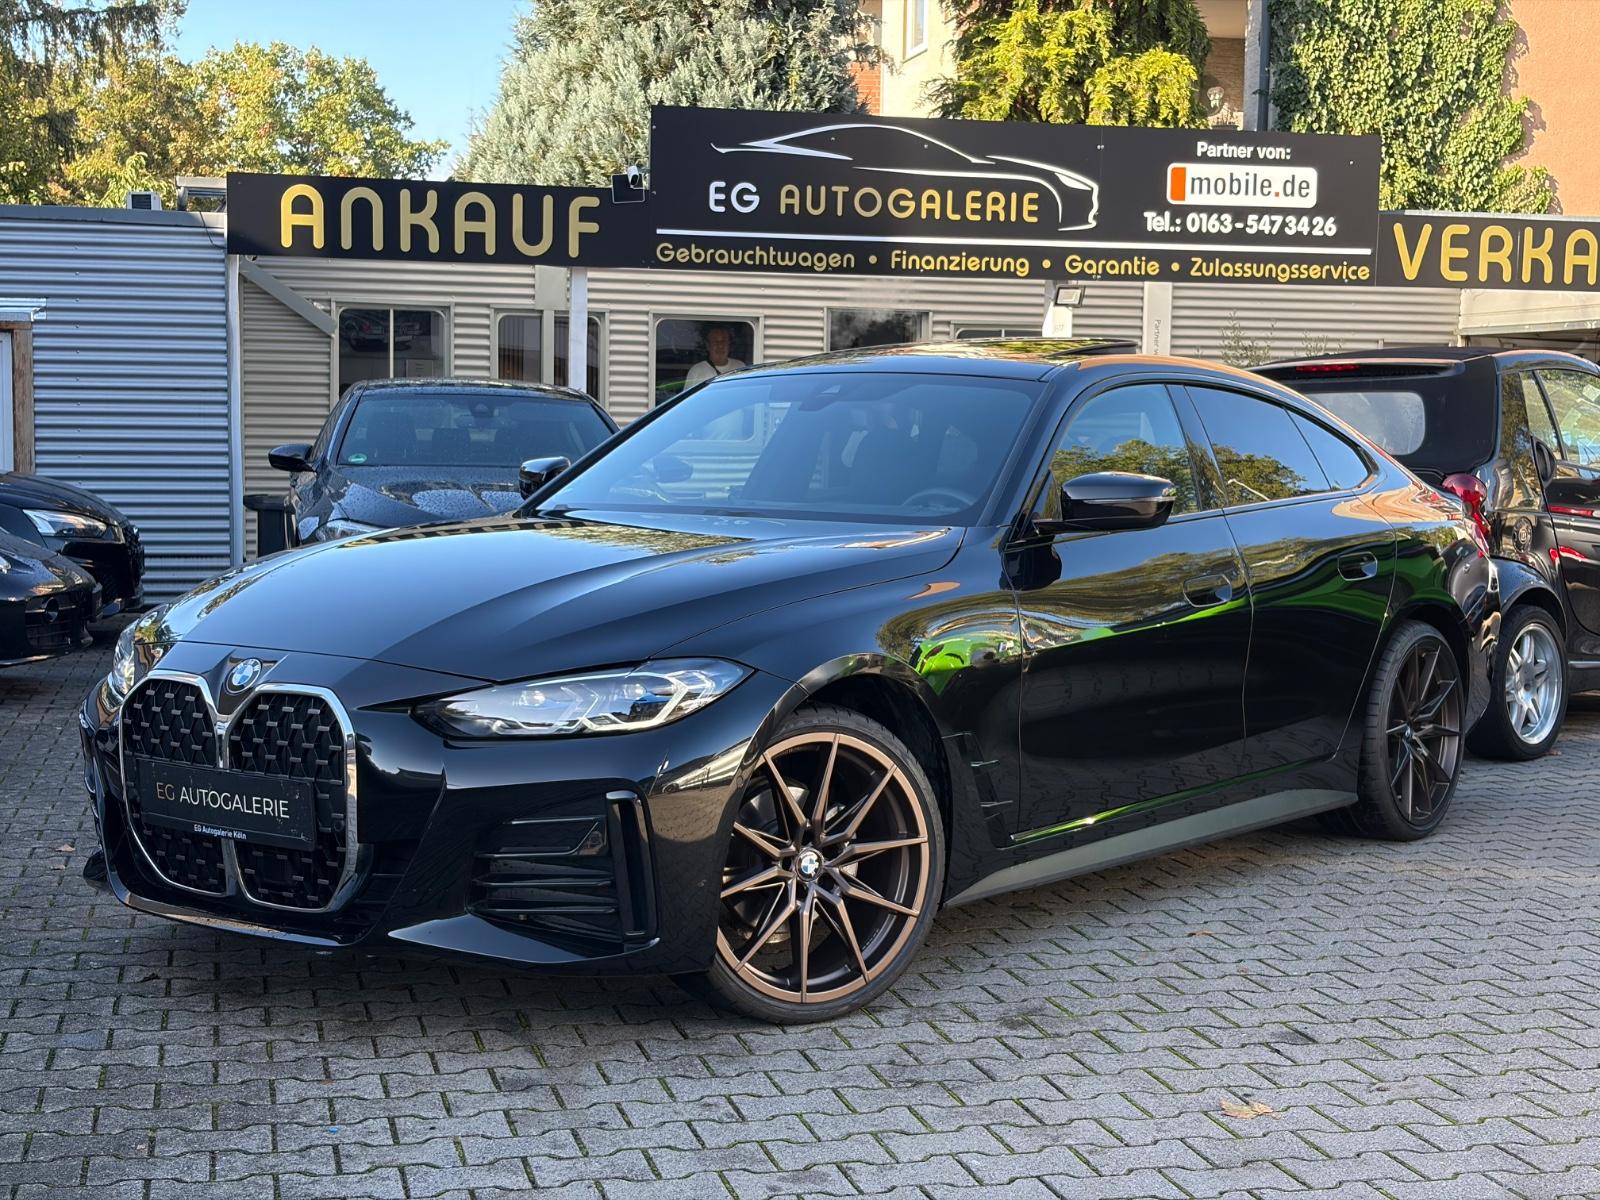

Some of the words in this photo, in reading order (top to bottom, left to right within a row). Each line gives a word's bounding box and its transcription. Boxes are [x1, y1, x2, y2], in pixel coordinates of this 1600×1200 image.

[1196, 141, 1254, 159] Partner
[1257, 146, 1292, 160] von:
[1190, 172, 1311, 198] mobile.de
[709, 181, 761, 214] EG
[779, 184, 1040, 223] AUTOGALERIE
[280, 184, 600, 258] ANKAUF
[1143, 211, 1182, 232] Tel.:
[1186, 212, 1338, 236] 0163-5473426
[655, 242, 855, 272] Gebrauchtwagen
[890, 249, 1030, 278] Finanzierung
[1064, 254, 1161, 275] Garantie
[1189, 257, 1371, 283] Zulassungsservice
[156, 782, 176, 801] EG
[179, 786, 290, 819] AUTOGALERIE
[193, 823, 202, 832] EG
[202, 825, 233, 838] Autogalerie
[233, 830, 247, 840] Köln
